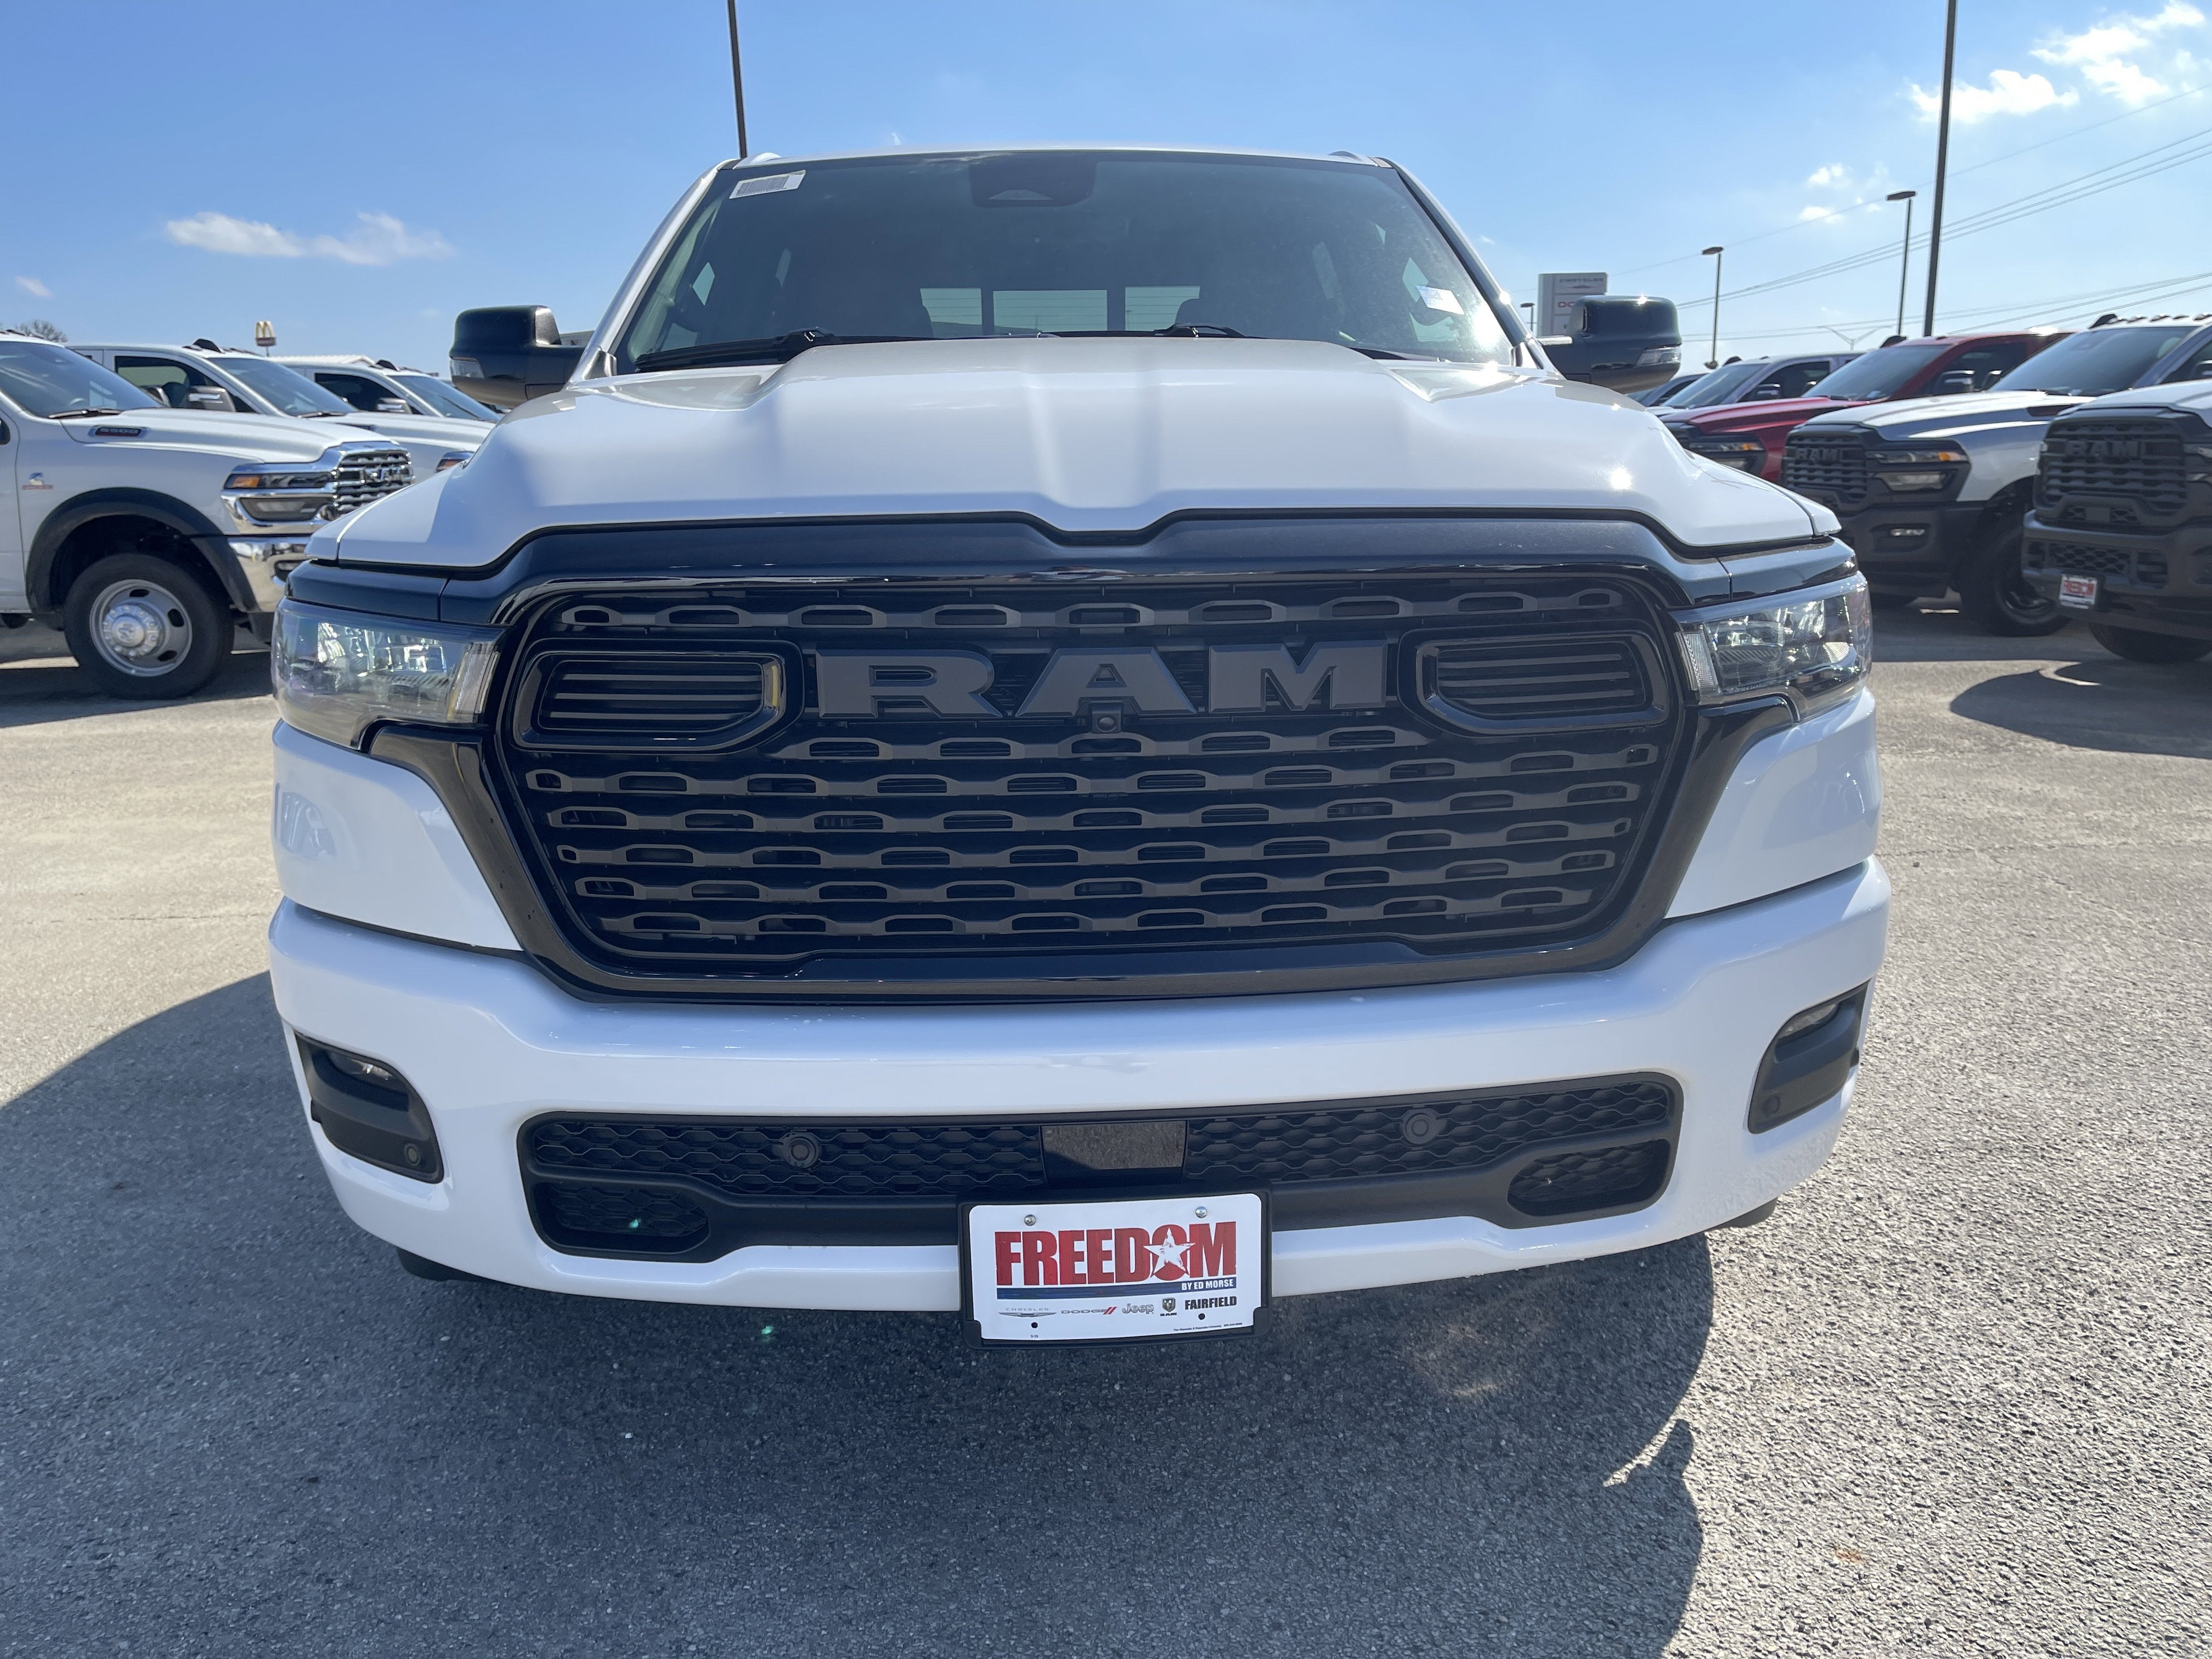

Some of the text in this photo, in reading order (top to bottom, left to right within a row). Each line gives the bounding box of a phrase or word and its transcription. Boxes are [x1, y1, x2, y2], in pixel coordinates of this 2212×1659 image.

[2064, 440, 2138, 457] RAM
[815, 639, 1388, 719] RAM
[994, 1221, 1237, 1285] FREEDOM
[1181, 1279, 1234, 1291] BY ED MORSE
[1122, 1304, 1154, 1314] Jeep
[1185, 1296, 1237, 1310] FAIRFIELD
